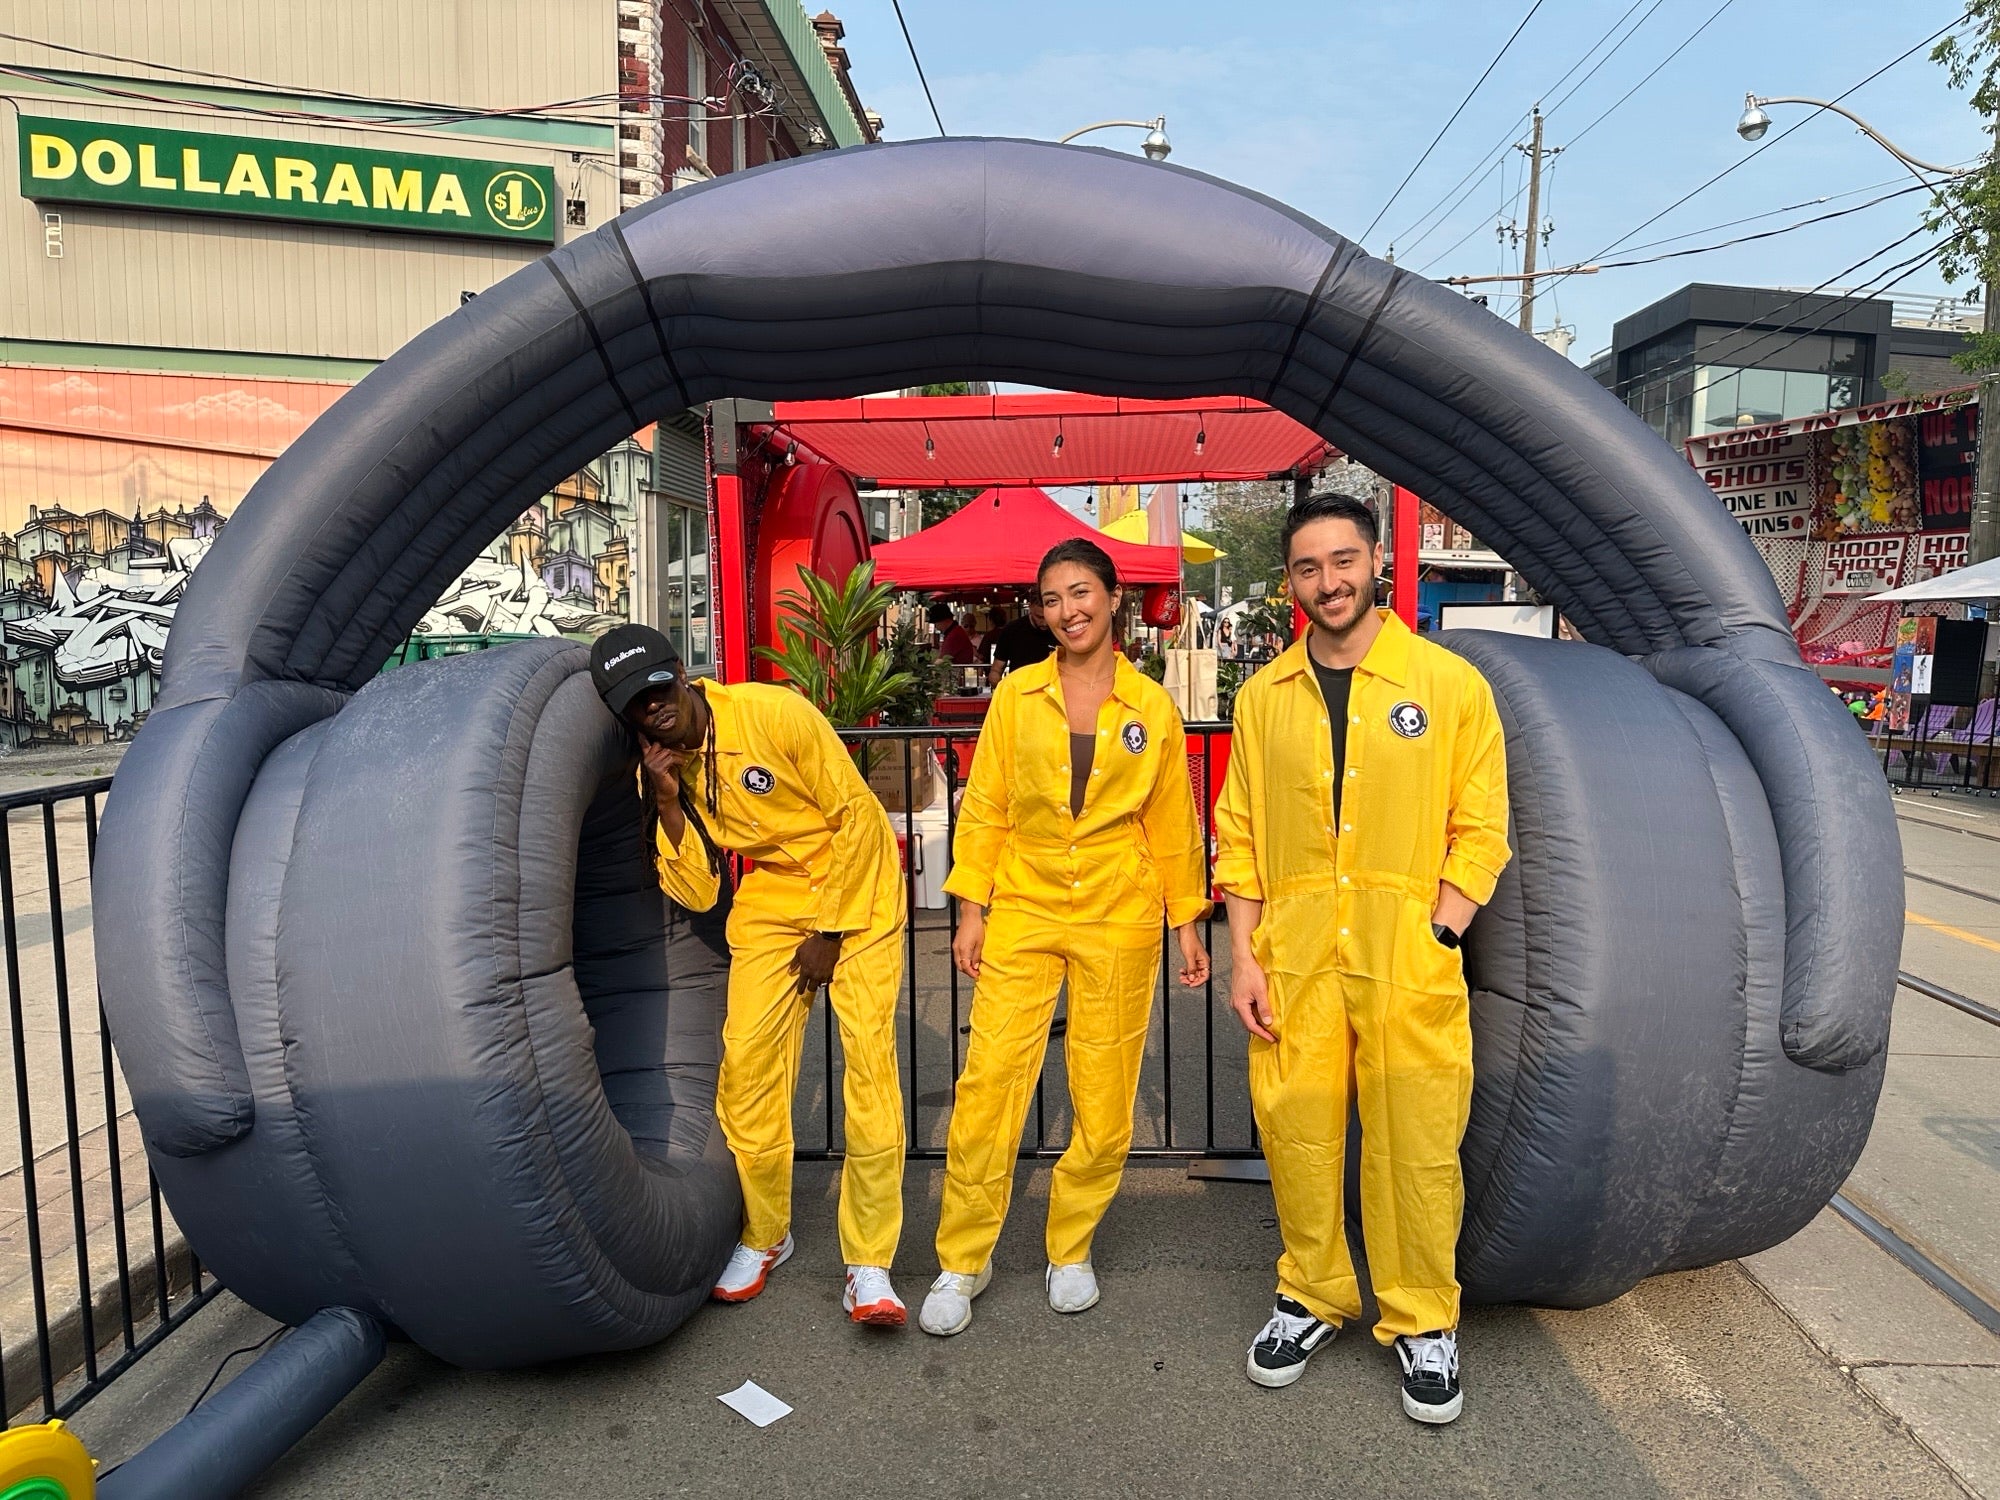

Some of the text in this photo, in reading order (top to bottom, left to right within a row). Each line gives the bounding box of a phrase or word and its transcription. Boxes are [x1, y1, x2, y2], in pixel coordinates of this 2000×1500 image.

[30, 134, 472, 217] DOLLARAMA
[494, 180, 526, 220] $1
[1726, 424, 1791, 444] ONE
[1802, 412, 1842, 432] IN
[1922, 411, 1958, 447] WE
[1704, 460, 1805, 489] SHOTS
[1722, 489, 1798, 512] ONE IN
[1828, 540, 1900, 558] HOOP
[1924, 536, 1970, 554] HO
[1828, 557, 1898, 571] SHOTS
[1847, 577, 1872, 587] WINS
